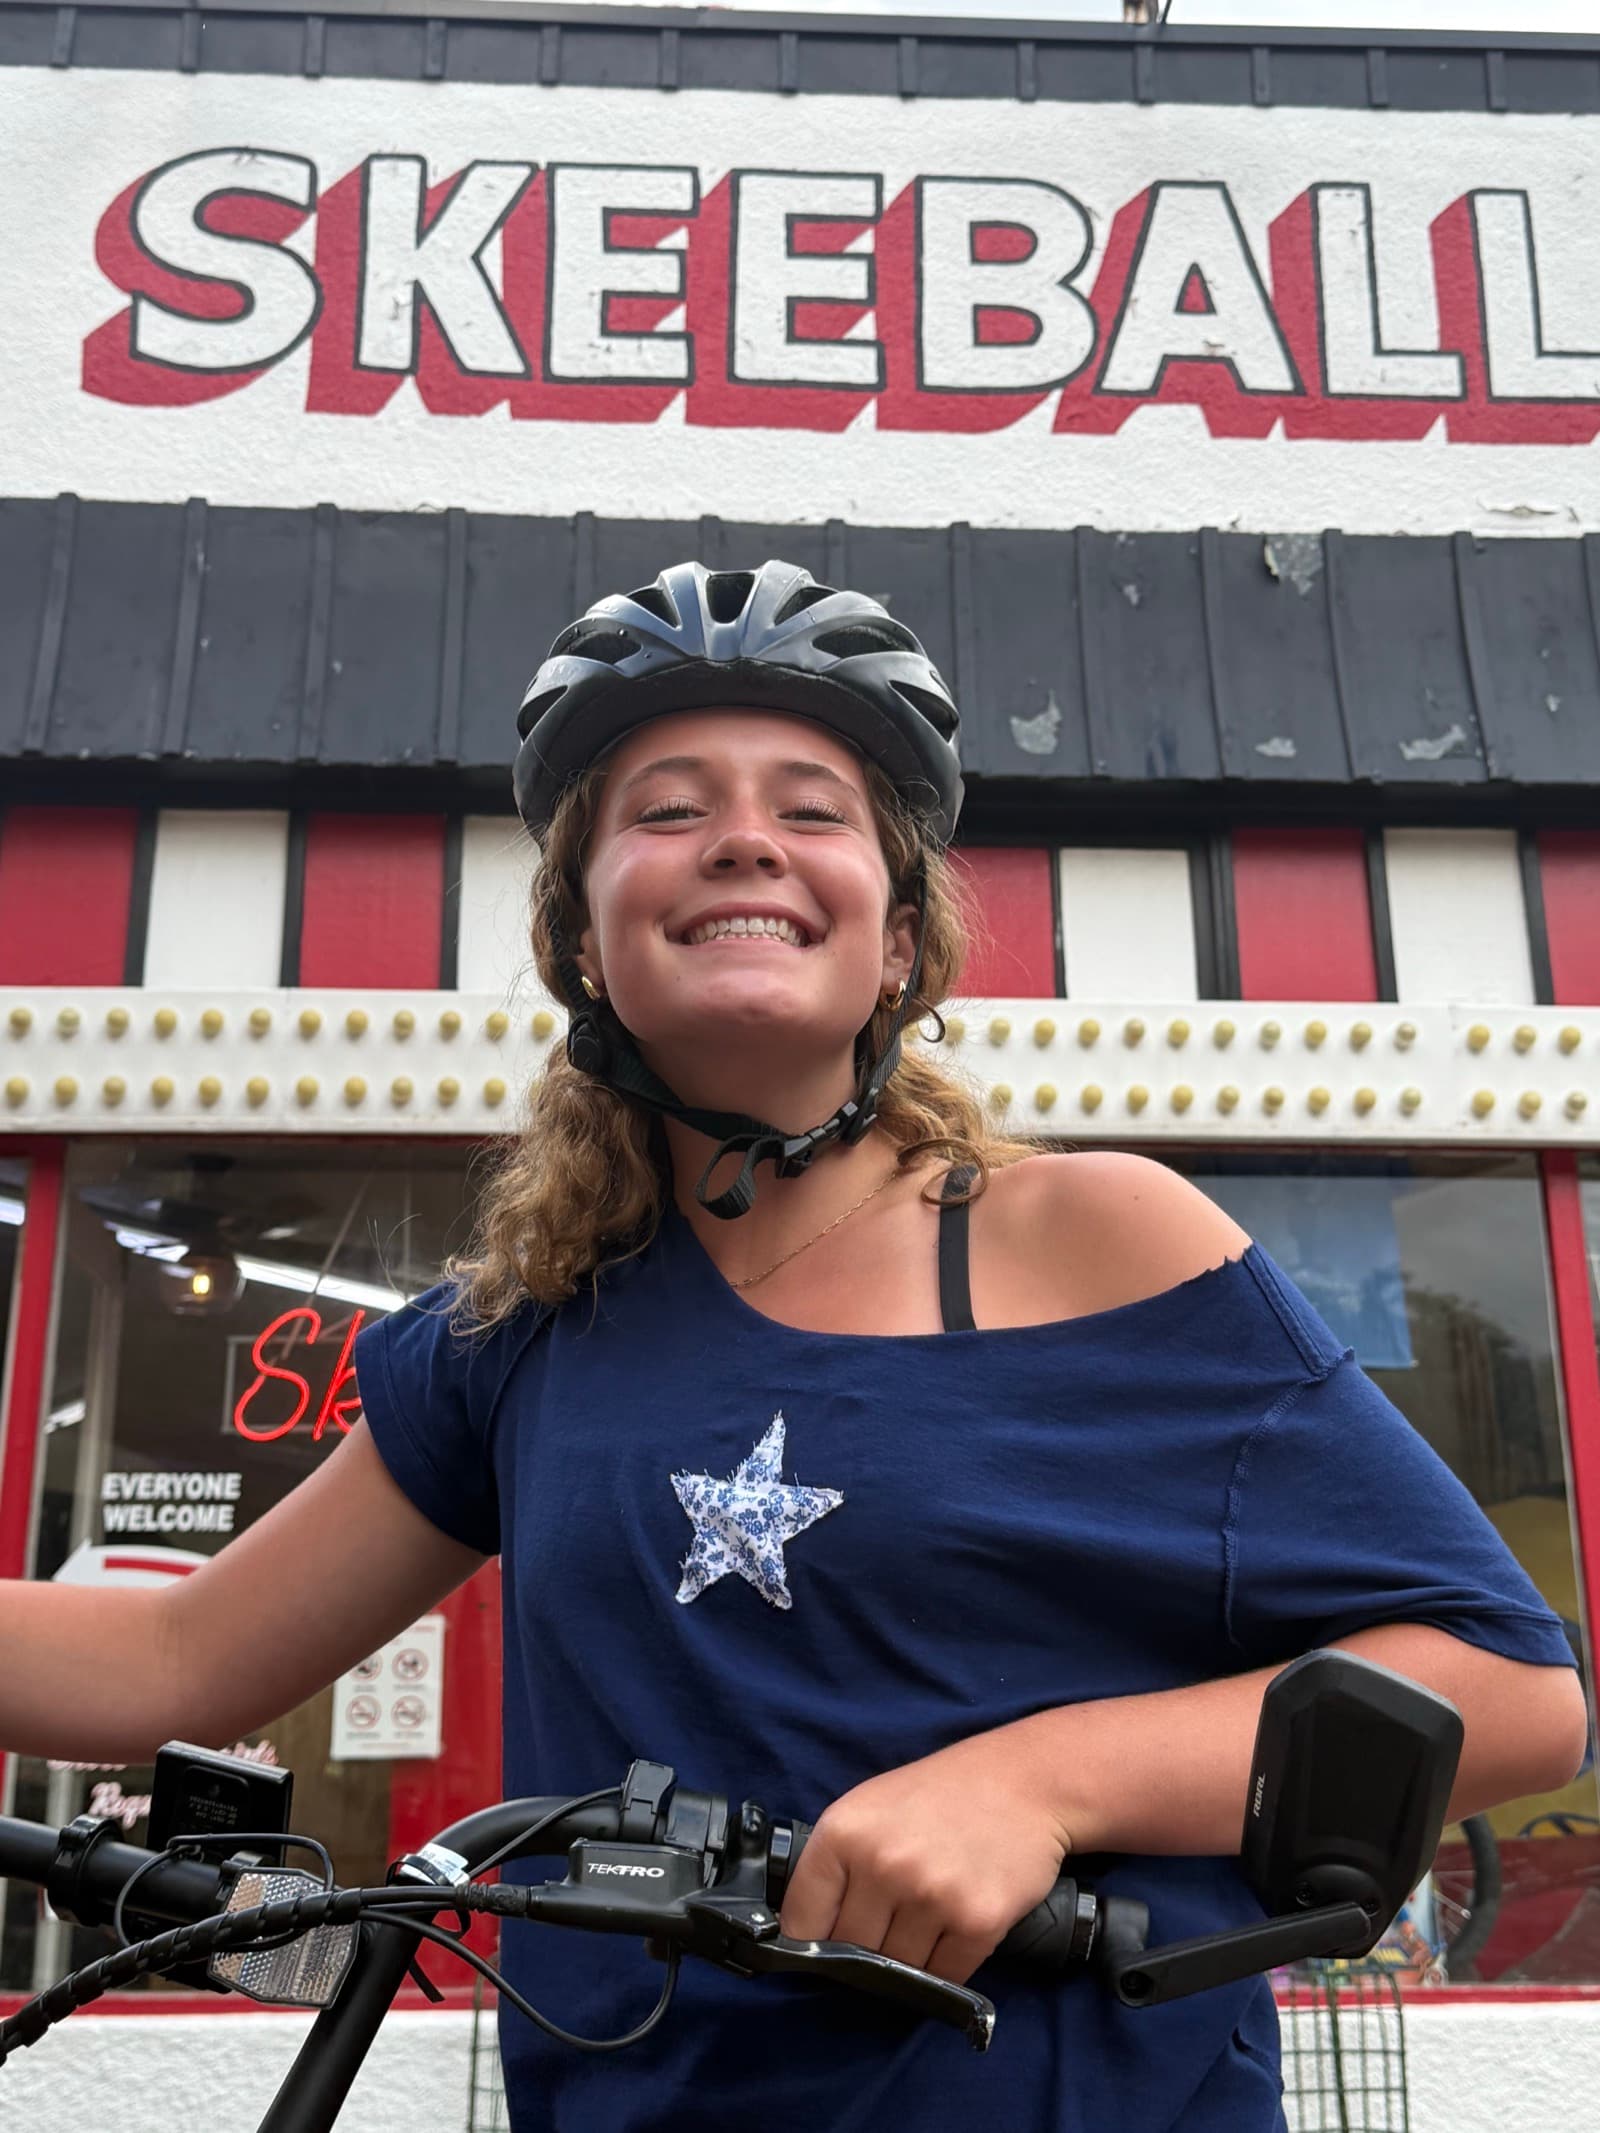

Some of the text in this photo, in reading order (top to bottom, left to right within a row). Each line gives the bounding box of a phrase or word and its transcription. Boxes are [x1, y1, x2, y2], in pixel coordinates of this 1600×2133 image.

[82, 146, 1600, 444] SKEEBALL
[102, 1472, 242, 1500] EVERYONE
[103, 1504, 234, 1532] WELCOME
[588, 1863, 664, 1878] TEKTRO
